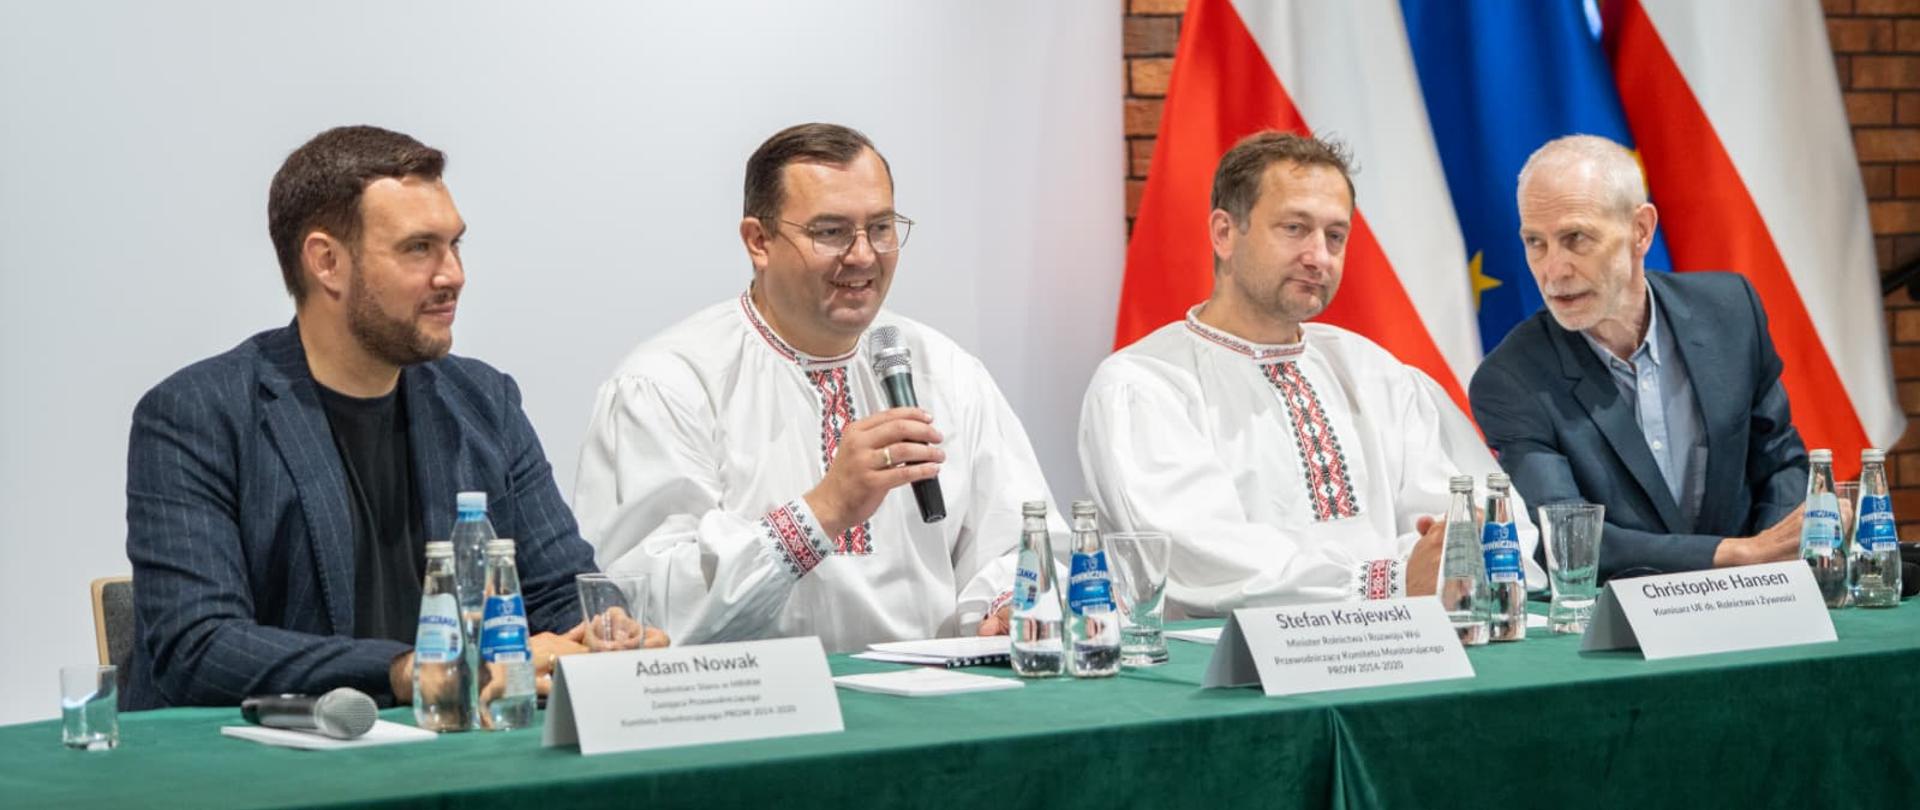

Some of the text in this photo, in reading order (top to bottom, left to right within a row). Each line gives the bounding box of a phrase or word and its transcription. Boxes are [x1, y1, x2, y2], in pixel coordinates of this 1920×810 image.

[1642, 572, 1790, 599] Christophe Hansen
[1692, 603, 1704, 613] UE
[1716, 598, 1755, 609] Rolnictwa
[1276, 605, 1412, 630] Stefan Krajewski
[1287, 638, 1321, 648] Minister
[1322, 634, 1363, 646] Rolnictwa
[1368, 631, 1403, 643] Rozwoju
[1342, 649, 1380, 661] Komitetu
[1381, 644, 1445, 657] Monitorującego
[635, 653, 759, 677] Adam Nowak
[1327, 664, 1356, 675] PROW
